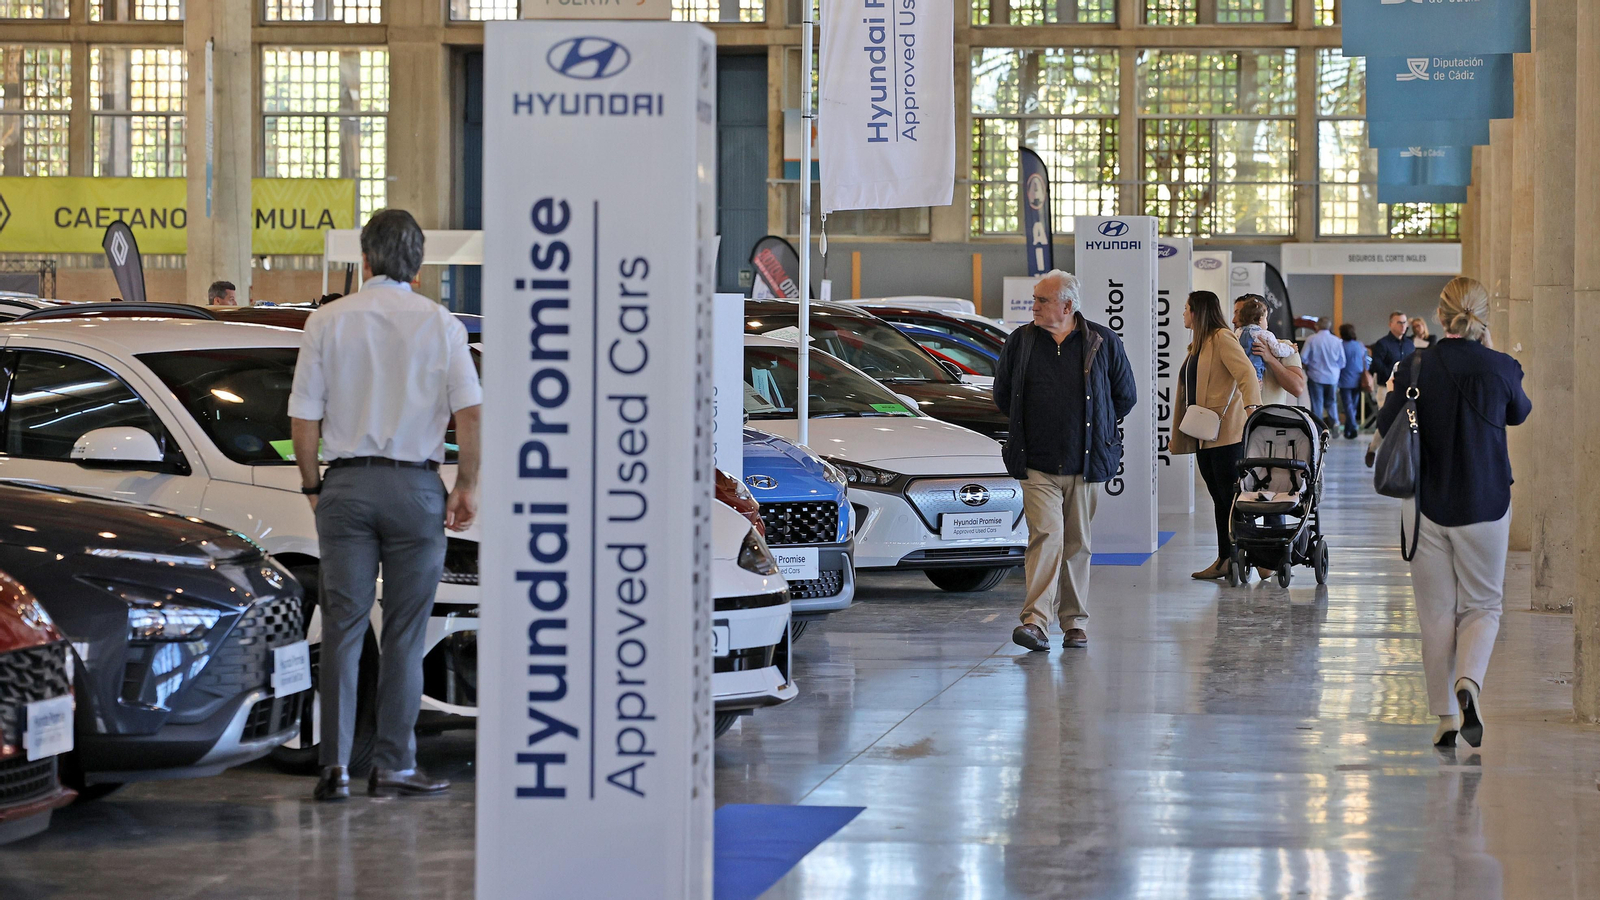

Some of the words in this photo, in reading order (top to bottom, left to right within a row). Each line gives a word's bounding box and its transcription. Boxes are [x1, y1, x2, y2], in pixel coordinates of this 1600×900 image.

[899, 0, 916, 26] Us
[1433, 57, 1484, 69] Diputación
[1433, 71, 1445, 81] de
[1448, 70, 1475, 80] Cádiz
[863, 18, 893, 142] Hyundai
[899, 33, 920, 142] Approved
[512, 92, 664, 116] HYUNDAI
[54, 207, 188, 229] CAETANO
[252, 208, 336, 230] MULA
[1085, 241, 1141, 250] HYUNDAI
[1348, 254, 1376, 262] SEGUROS
[1377, 254, 1384, 262] EL
[1385, 254, 1404, 262] CORTE
[608, 256, 650, 375] Cars
[1105, 279, 1125, 337] otor
[513, 196, 572, 479] Promise
[606, 395, 649, 524] Used
[953, 518, 978, 527] Hyundai
[979, 516, 1002, 525] Promise
[778, 555, 806, 564] Promise
[513, 502, 580, 799] Hyundai
[606, 543, 656, 797] Approved
